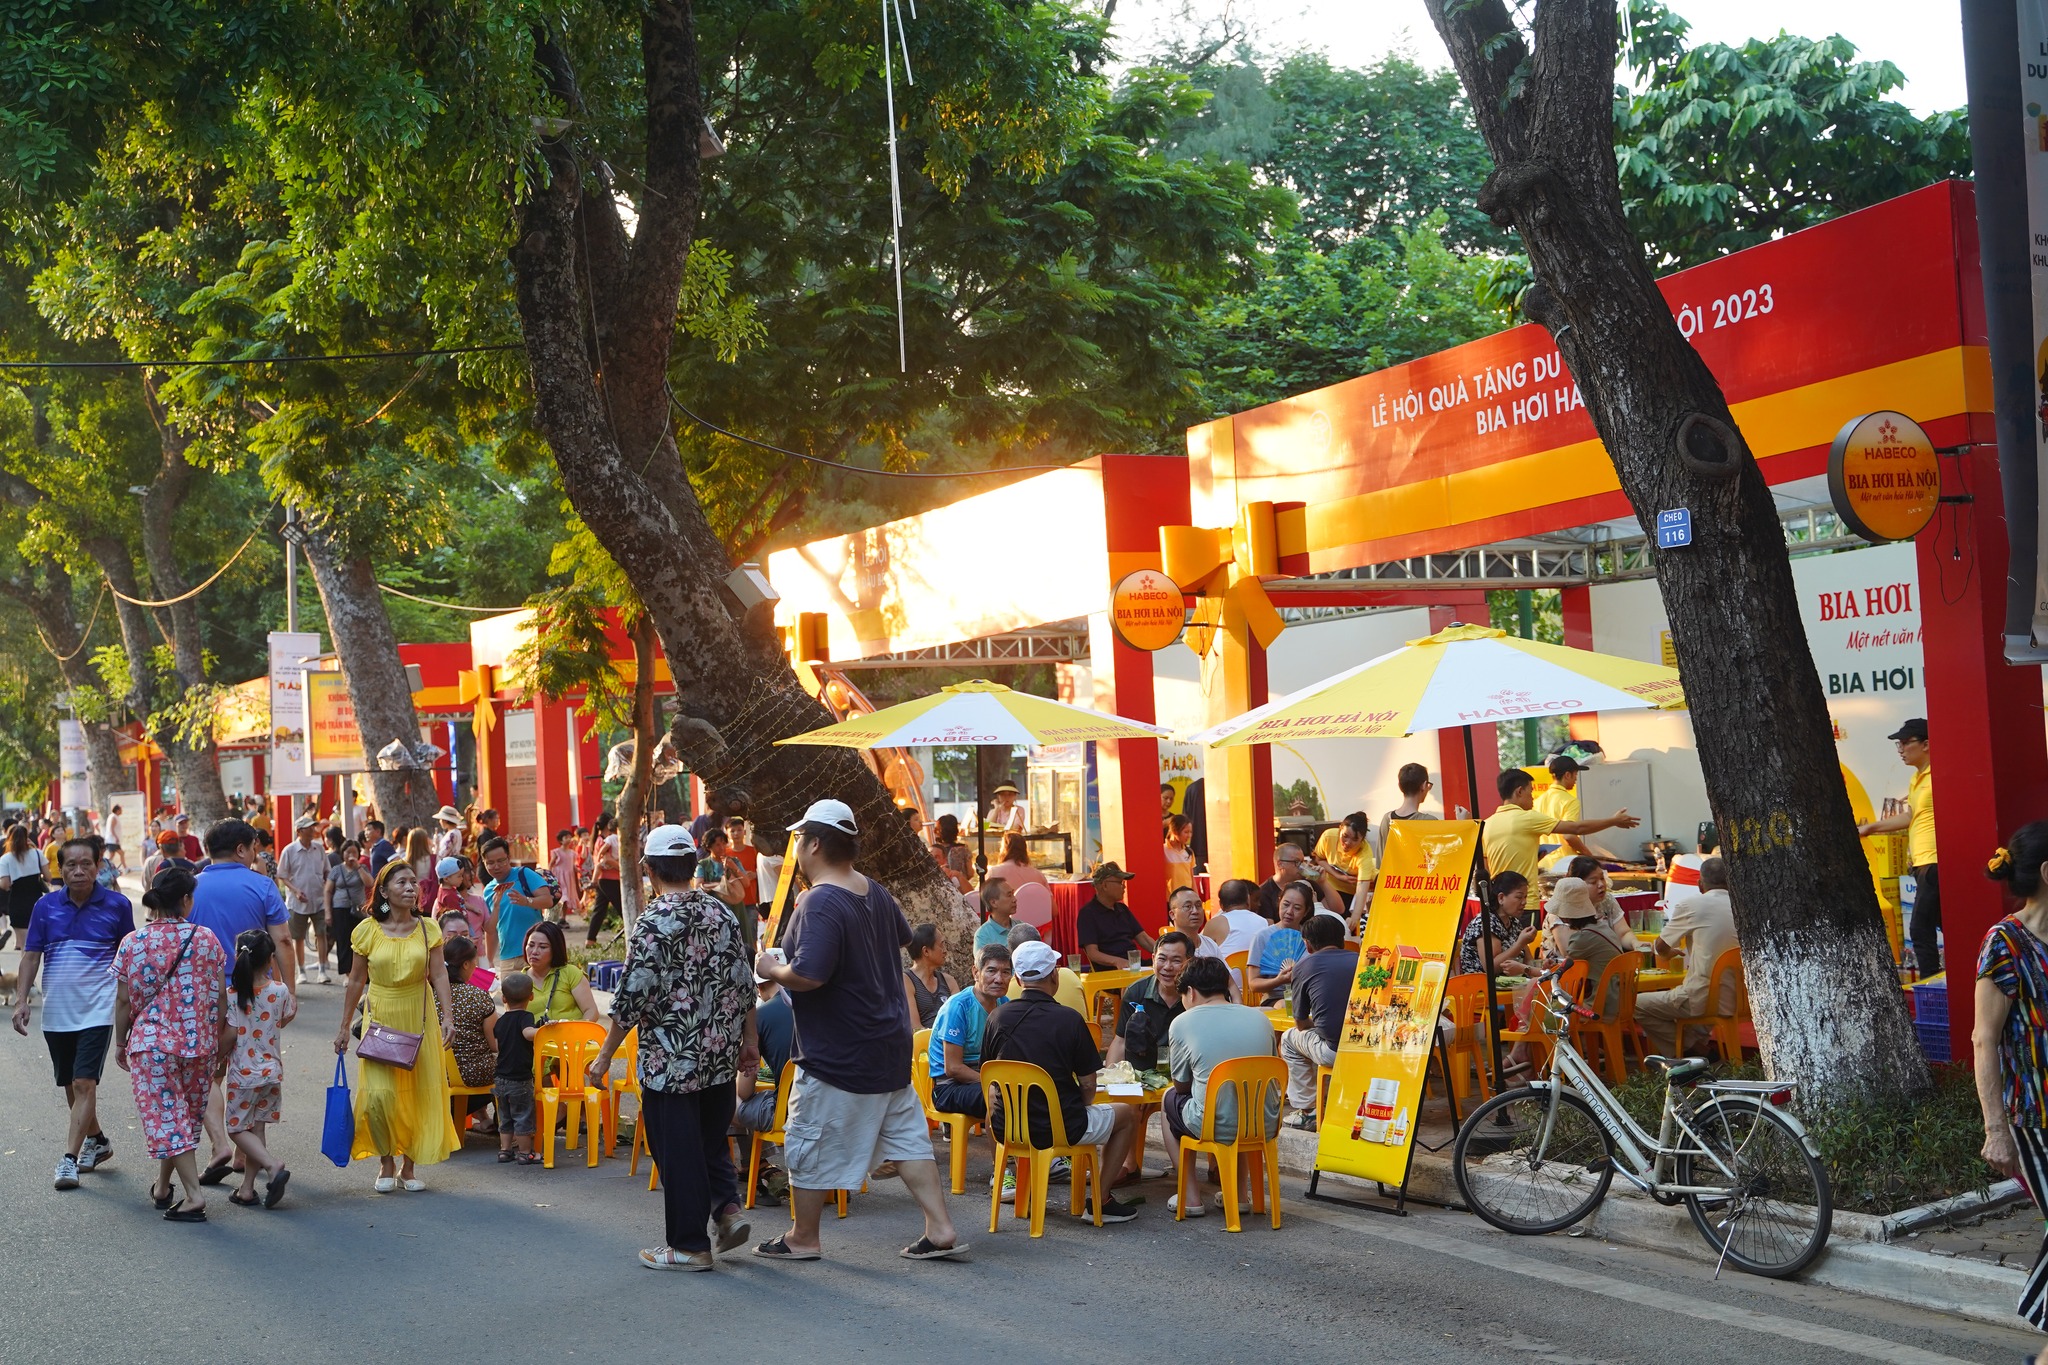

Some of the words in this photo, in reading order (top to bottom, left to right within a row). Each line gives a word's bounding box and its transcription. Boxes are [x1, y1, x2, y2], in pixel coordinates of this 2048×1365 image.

[2027, 63, 2048, 79] DU
[2034, 233, 2048, 246] KH
[1371, 393, 1388, 428] LỄ
[1393, 388, 1424, 422] HỘI
[1429, 374, 1470, 412] QUÀ
[1473, 366, 1527, 400] TẶNG
[1533, 351, 1560, 382] DU
[1673, 303, 1703, 342] ỘI
[1712, 284, 1774, 328] 2023
[1476, 405, 1508, 435] BIA
[1512, 392, 1548, 425] HƠI
[1554, 379, 1585, 414] HÀ
[1864, 447, 1917, 460] HABECO
[1848, 474, 1870, 489] BIA
[1871, 472, 1895, 488] HƠI
[1896, 469, 1914, 487] HÀ
[1916, 469, 1938, 490] NỘI
[1665, 529, 1685, 542] 116
[1129, 592, 1168, 600] HABECO
[1818, 590, 1861, 621] BIA
[1864, 583, 1912, 616] HƠI
[1117, 609, 1132, 619] BIA
[1134, 608, 1151, 618] HƠI
[1153, 606, 1165, 617] HÀ
[1167, 606, 1183, 619] NỘI
[1846, 630, 1870, 652] Một
[1872, 628, 1891, 647] nét
[1892, 627, 1914, 645] văn
[1828, 672, 1865, 695] BIA
[1872, 665, 1914, 692] HƠI
[1257, 718, 1291, 730] BIA
[1293, 715, 1333, 727] HƠI
[1331, 711, 1362, 724] HÀ
[1362, 710, 1400, 724] NỘI
[1458, 699, 1583, 721] HABECO
[911, 735, 998, 743] HABECO
[1384, 875, 1401, 889] BIA
[1403, 875, 1424, 890] HƠI
[1424, 873, 1439, 890] HÀ
[1440, 873, 1461, 894] NỘI
[948, 1028, 958, 1037] 5G
[1572, 1075, 1622, 1142] momentum
